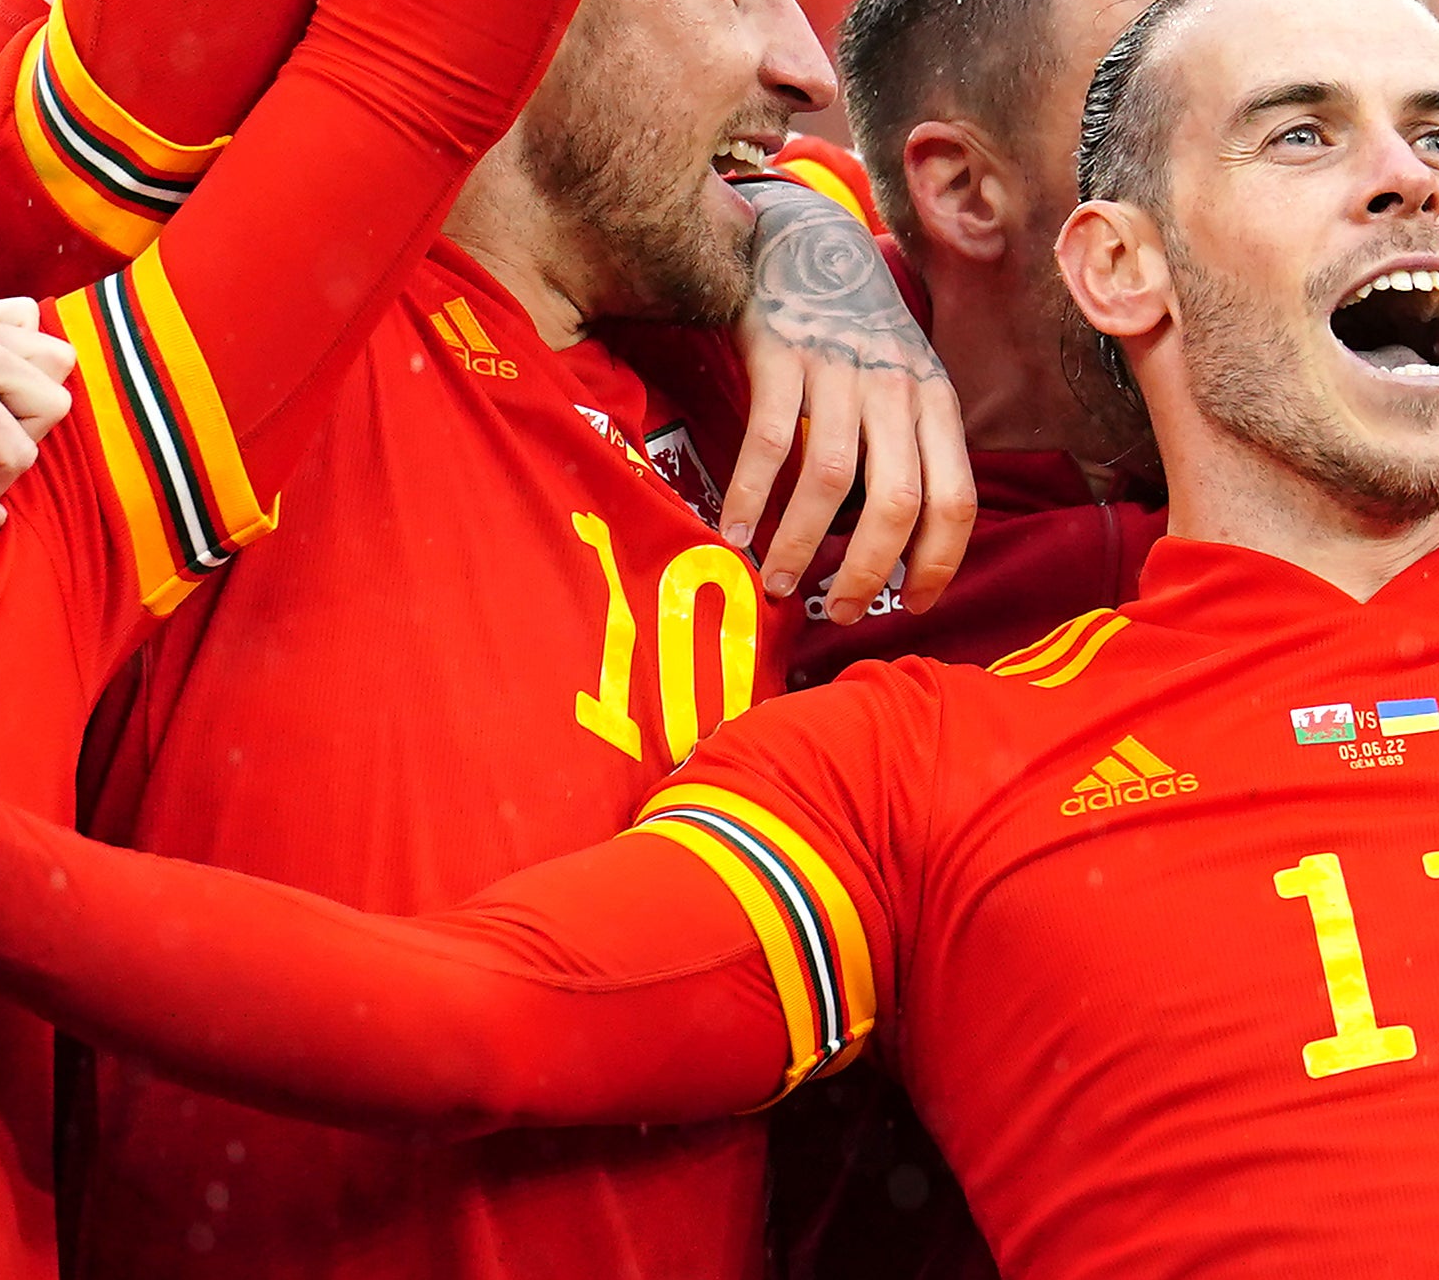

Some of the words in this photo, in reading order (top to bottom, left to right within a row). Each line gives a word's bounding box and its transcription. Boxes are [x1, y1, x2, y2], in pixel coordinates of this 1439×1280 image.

[571, 511, 758, 766] 10
[1355, 710, 1378, 730] VS
[1338, 738, 1407, 761] 05.06.22
[1378, 754, 1404, 767] 689
[1061, 769, 1199, 817] adidas
